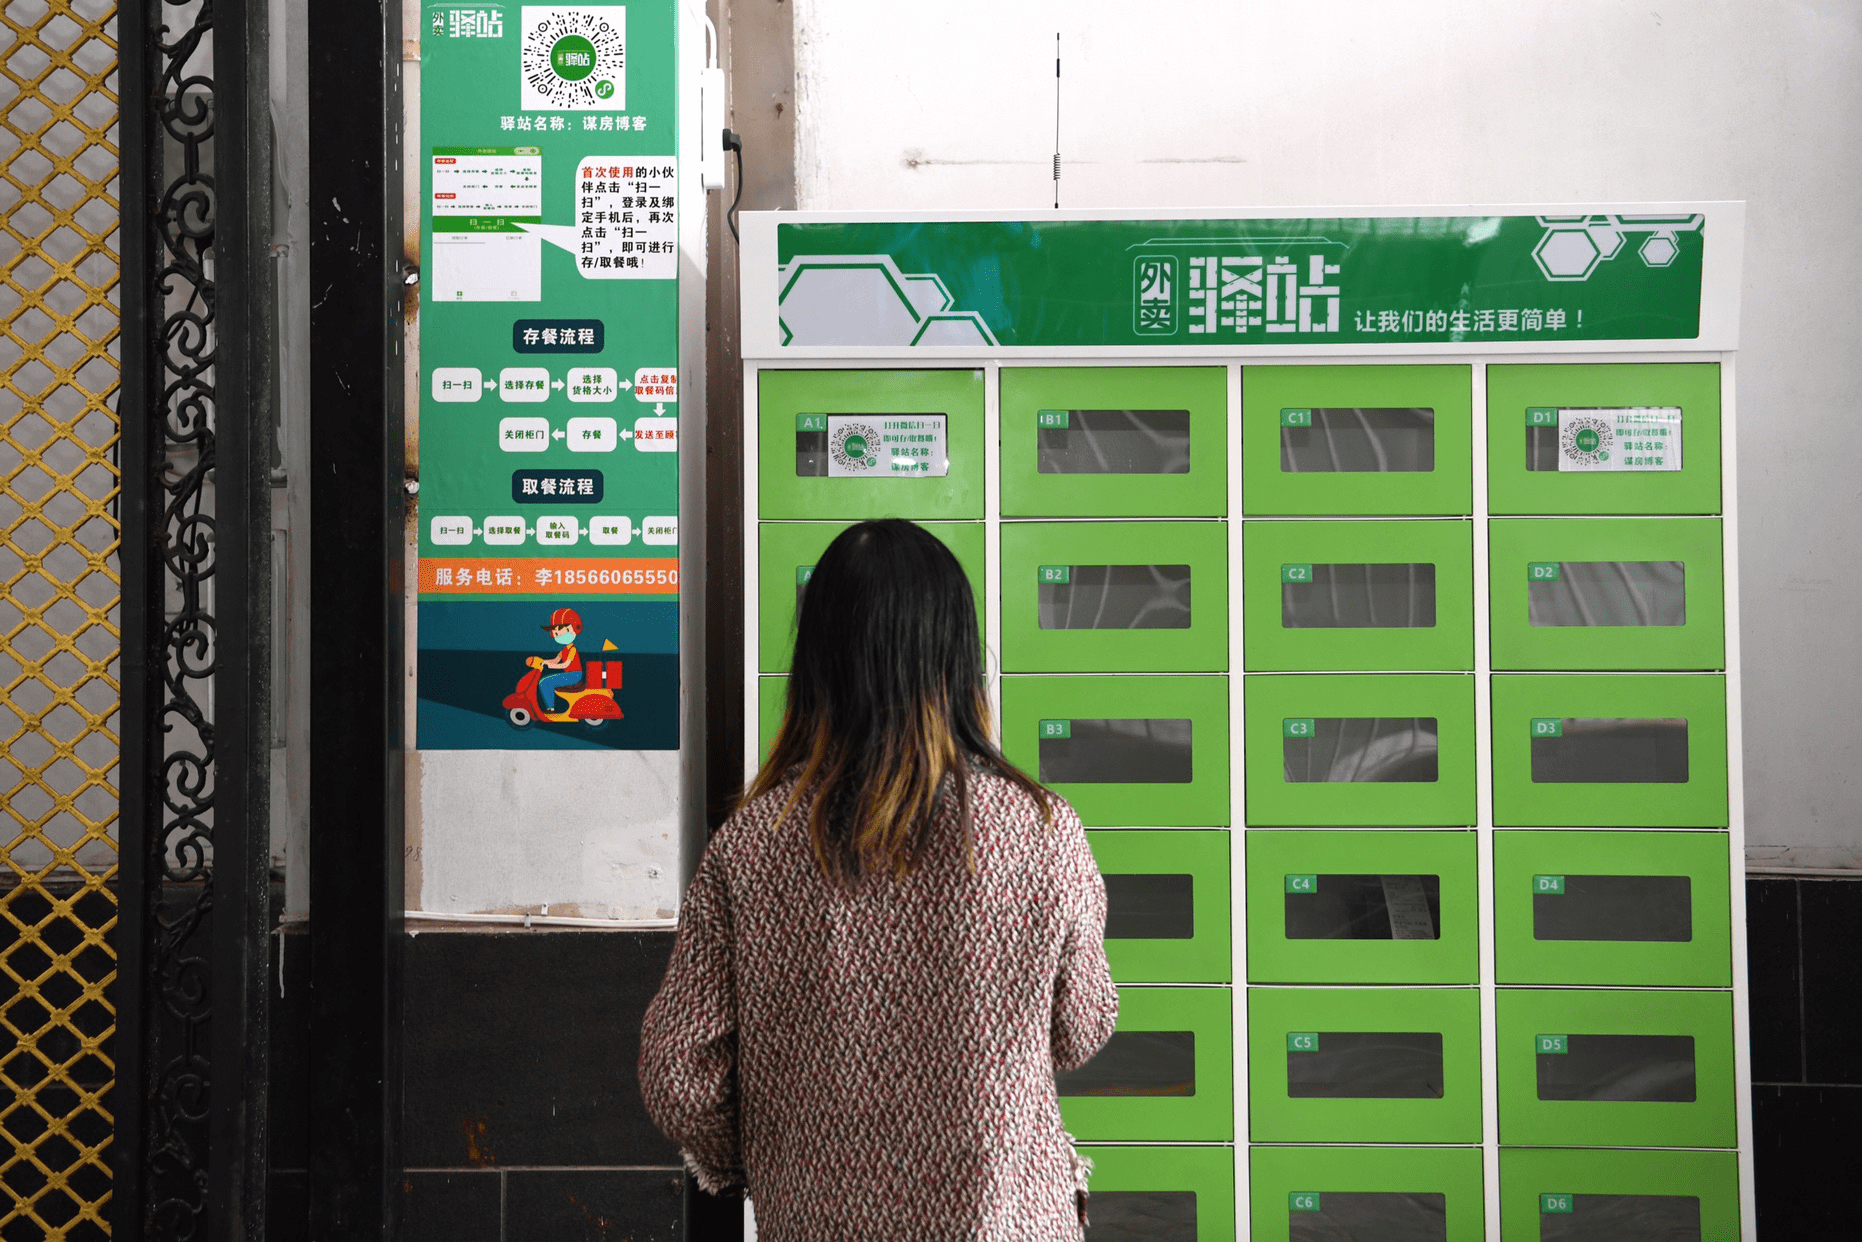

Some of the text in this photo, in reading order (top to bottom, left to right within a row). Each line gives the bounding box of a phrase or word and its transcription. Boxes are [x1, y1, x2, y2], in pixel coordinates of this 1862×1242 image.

[449, 10, 503, 37] 驿站
[581, 166, 674, 178] 首次使用的小伙
[581, 211, 674, 223] 定手机后，再次
[1141, 263, 1171, 328] 外卖
[1189, 255, 1340, 333] 驿站
[1354, 308, 1583, 333] 让我们的生活更简单！
[523, 328, 594, 345] 存餐流程
[582, 374, 602, 384] 选择
[442, 380, 472, 390] 扫一扫
[504, 380, 545, 390] 选择存餐
[572, 386, 612, 395] 货格大小
[635, 386, 677, 395] 取餐码信
[803, 417, 821, 428] A1
[1045, 414, 1061, 424] B1
[1288, 412, 1304, 423] C1
[1533, 412, 1551, 423] D1
[504, 430, 545, 440] 关闭柜门
[582, 430, 602, 440] 存餐
[635, 430, 677, 440] 发送至顾
[522, 478, 594, 495] 取餐流程
[440, 526, 465, 535] 扫一扫
[488, 526, 521, 535] 选择取餐
[549, 522, 566, 530] 输入
[602, 526, 619, 535] 取餐
[545, 531, 570, 539] 取餐码
[1045, 569, 1062, 580] B2
[1288, 568, 1305, 579] C2
[1534, 567, 1553, 577] D2
[1046, 724, 1063, 735] B3
[1290, 723, 1307, 734] C3
[1537, 723, 1555, 733] D3
[1292, 879, 1310, 889] C4
[1539, 879, 1558, 890] D4
[1294, 1037, 1311, 1048] C5
[1542, 1039, 1561, 1050] D5
[1296, 1196, 1313, 1207] C6
[1547, 1198, 1566, 1209] D6
